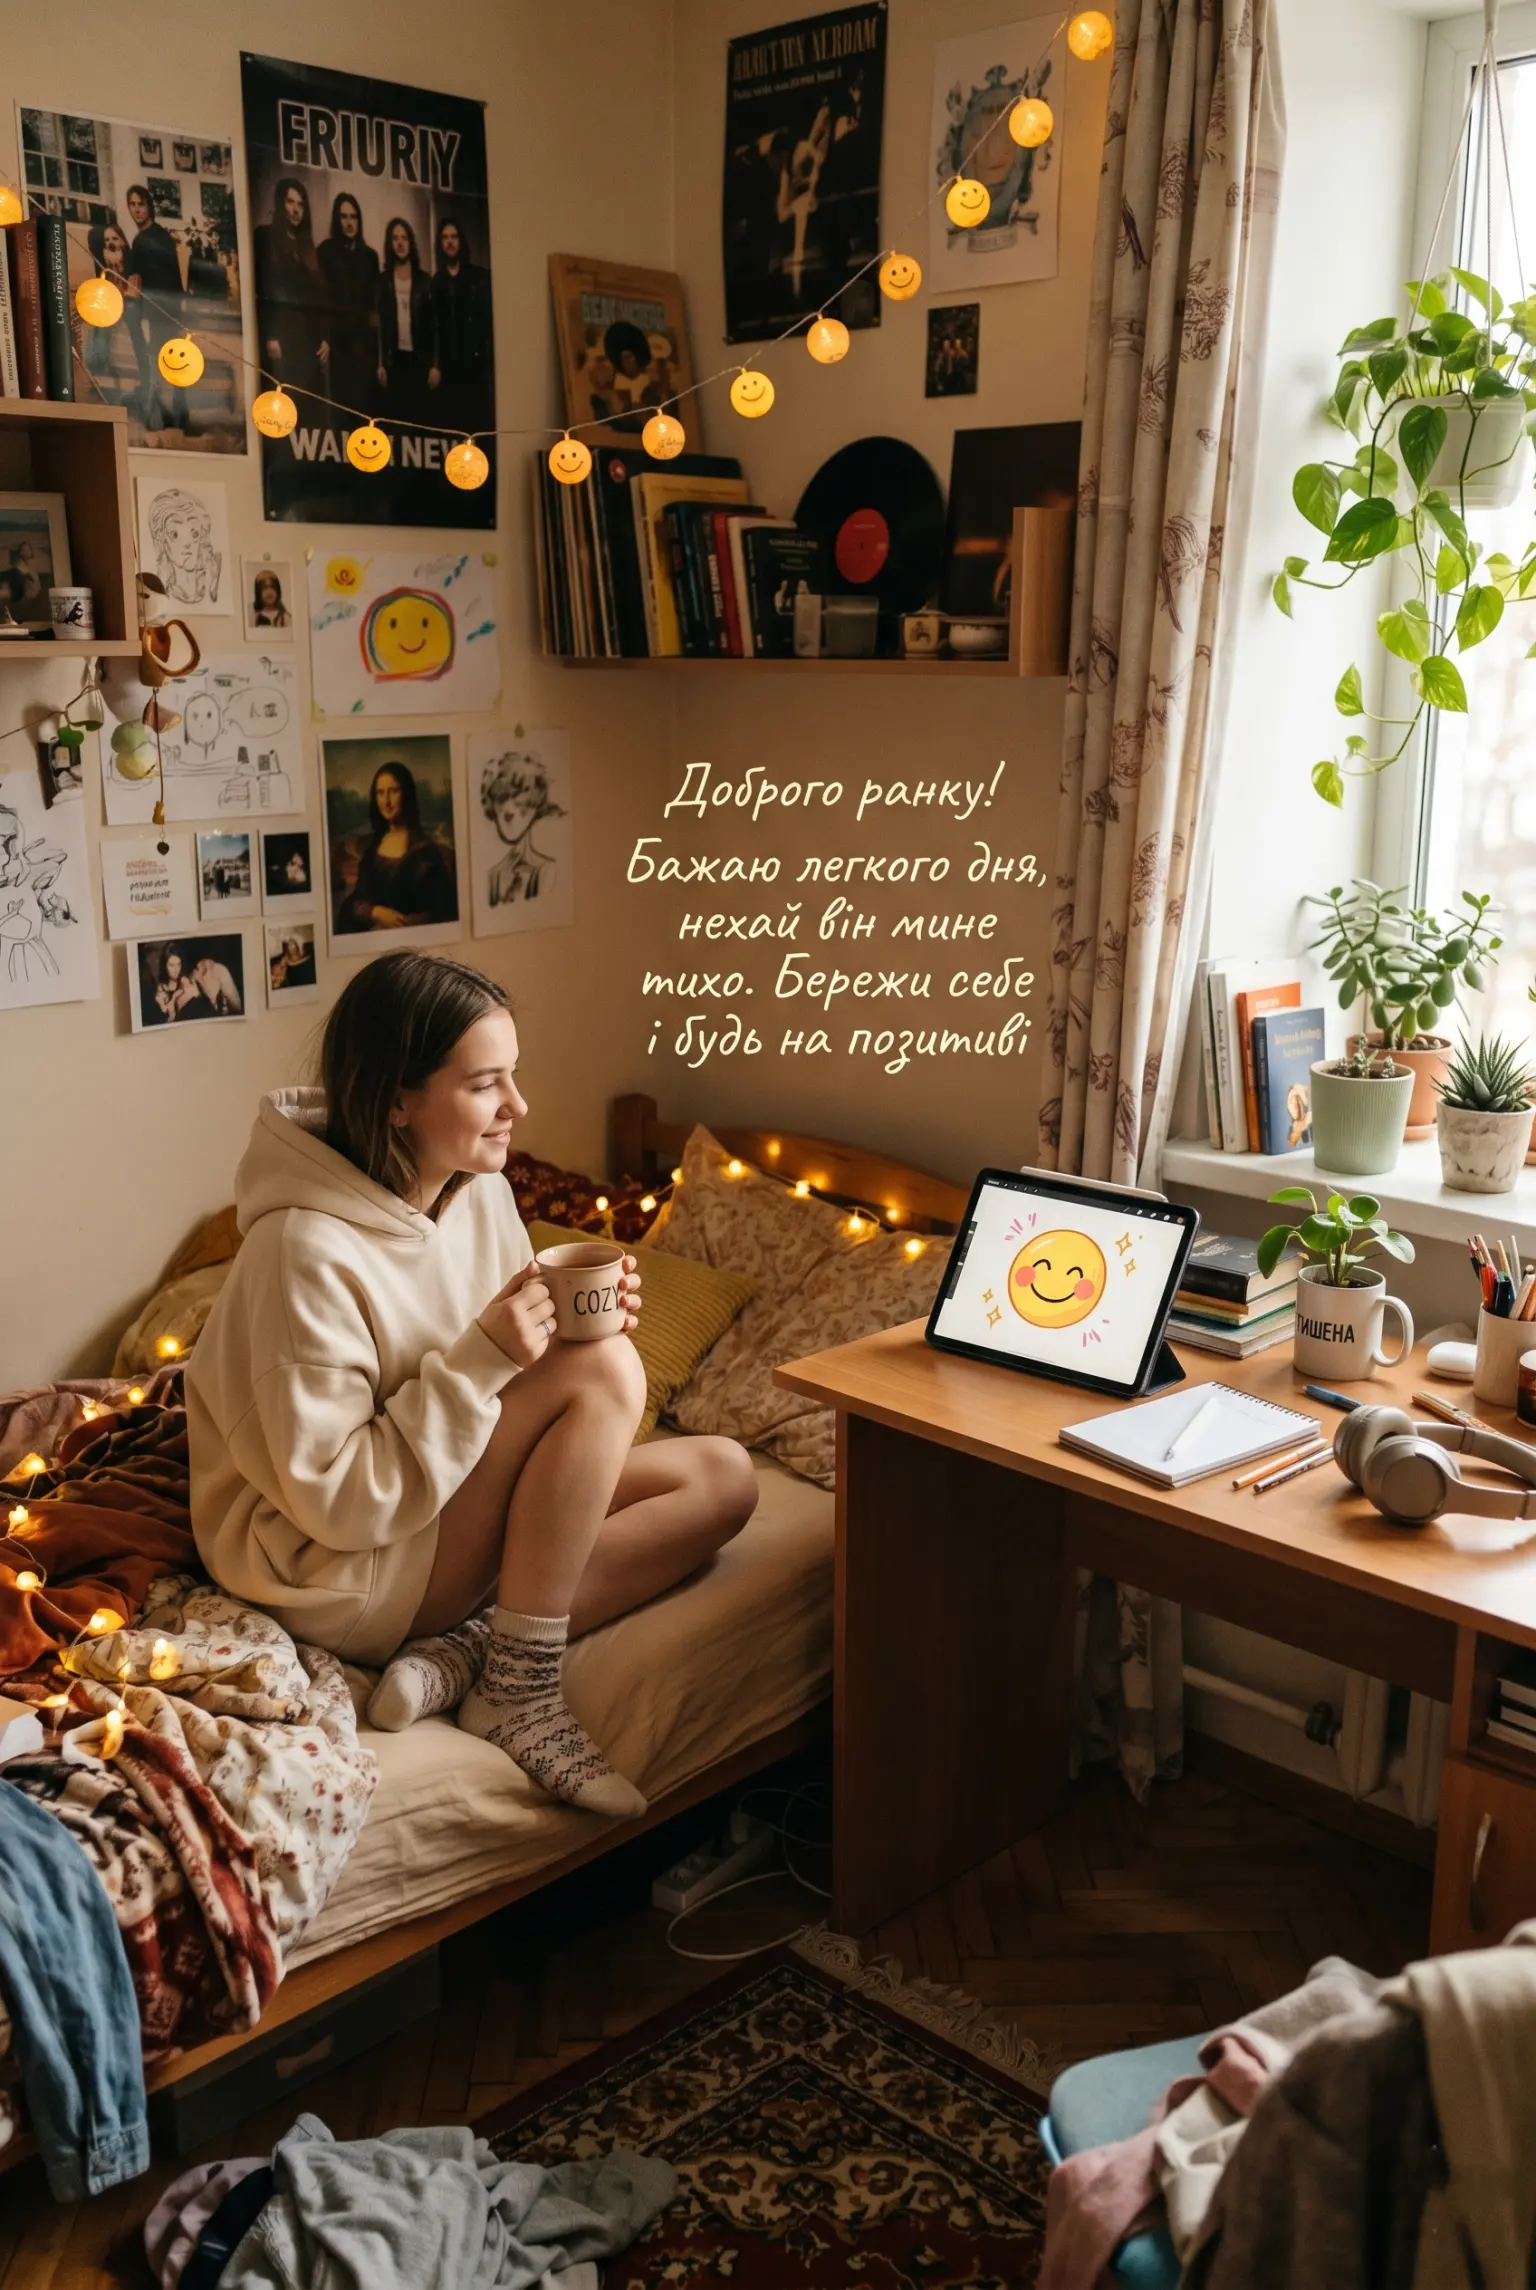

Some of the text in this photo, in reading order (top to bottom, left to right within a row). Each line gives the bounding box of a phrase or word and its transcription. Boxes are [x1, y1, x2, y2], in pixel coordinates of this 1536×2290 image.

[278, 98, 461, 192] FRIURIY
[573, 1285, 620, 1316] COZY
[1296, 1313, 1355, 1344] ТИШЕНА
